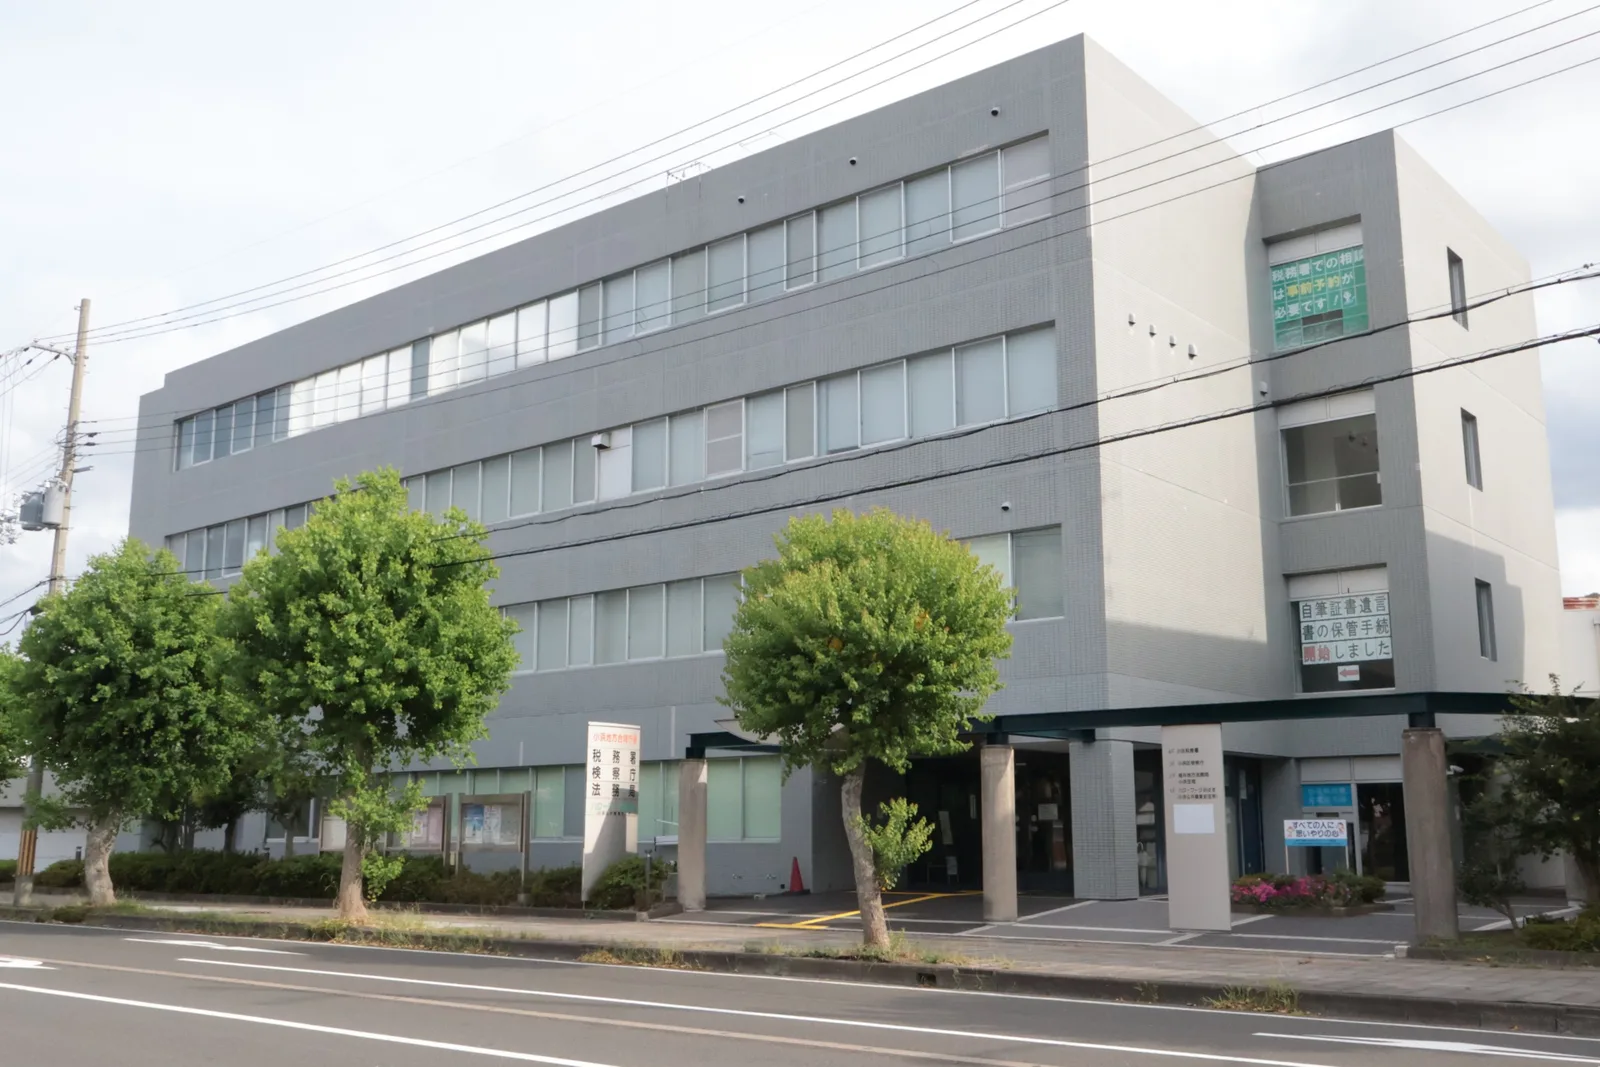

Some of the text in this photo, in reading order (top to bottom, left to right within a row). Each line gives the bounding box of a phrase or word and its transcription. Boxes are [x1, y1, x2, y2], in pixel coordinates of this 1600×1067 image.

[1302, 595, 1386, 619] 自筆証書遺言
[1302, 617, 1389, 641] 書の保管手続
[1303, 640, 1390, 662] 開始しました
[1292, 821, 1335, 830] すべての人に
[1295, 829, 1340, 838] 思いやりの心
